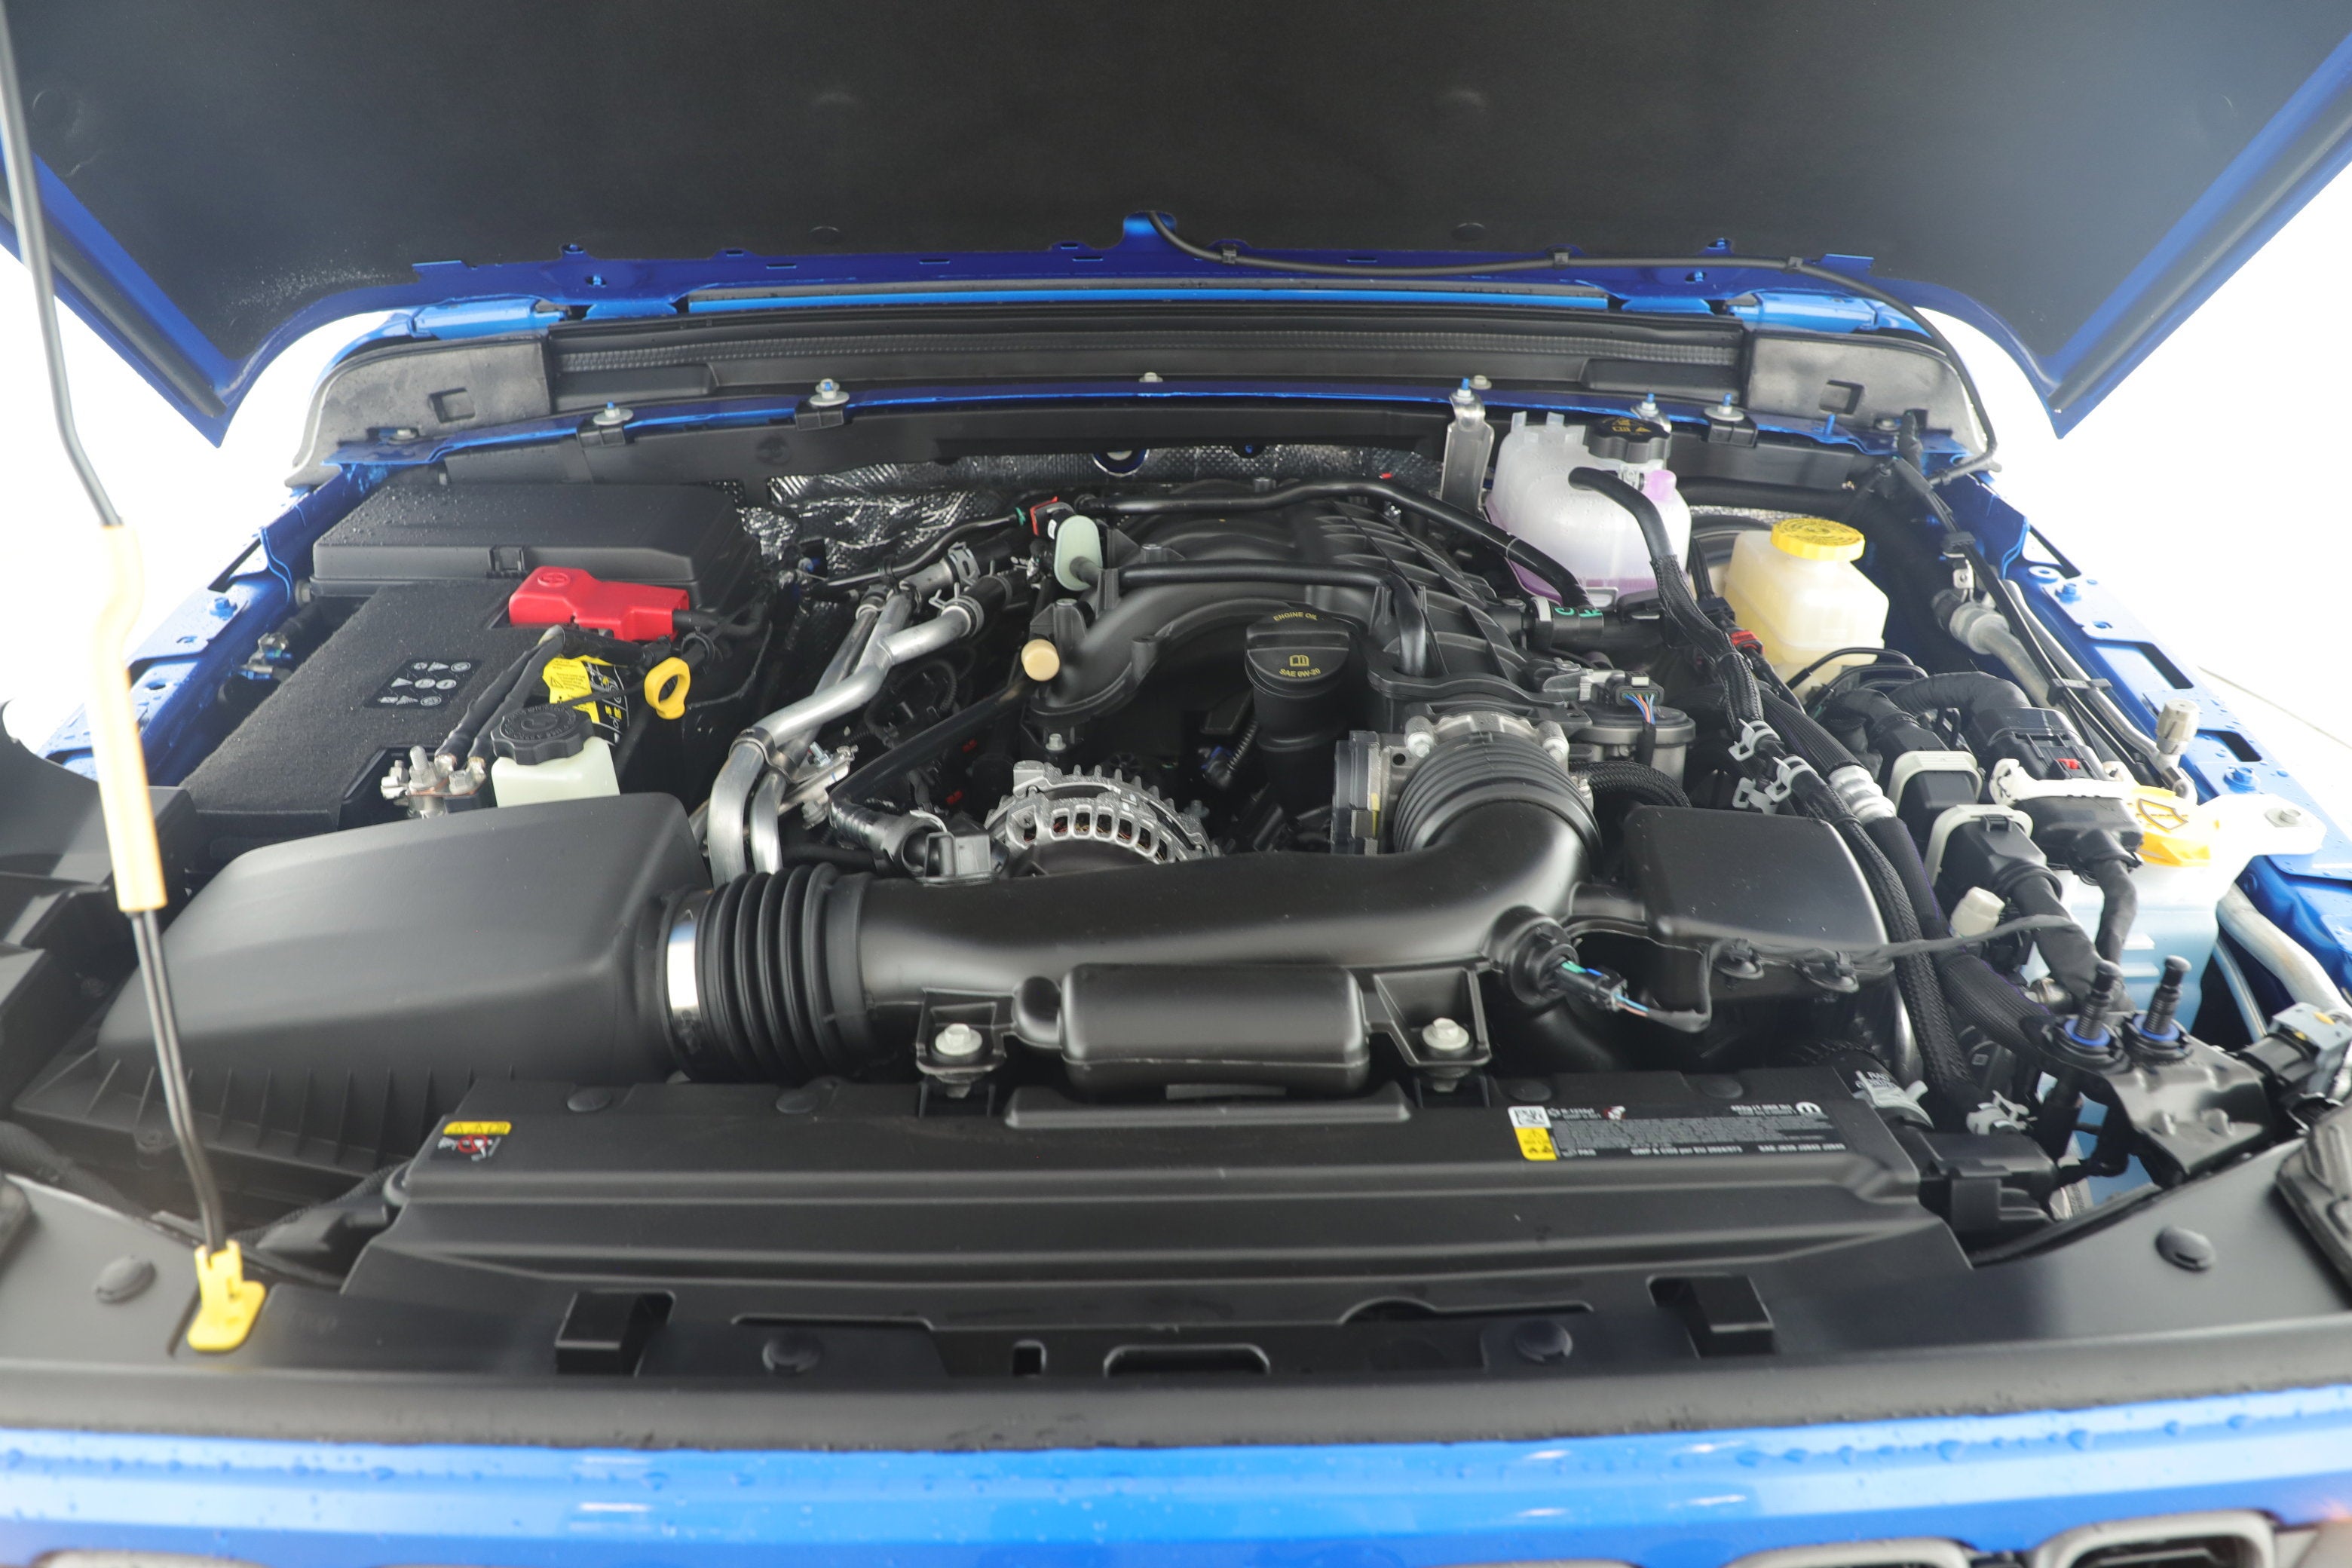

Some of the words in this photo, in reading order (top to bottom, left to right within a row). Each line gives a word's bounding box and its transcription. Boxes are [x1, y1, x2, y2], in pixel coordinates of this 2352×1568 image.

[1273, 611, 1304, 621] ENGINE
[1305, 612, 1318, 621] OIL
[1279, 668, 1296, 677] SAE
[1297, 668, 1321, 678] 0W-20
